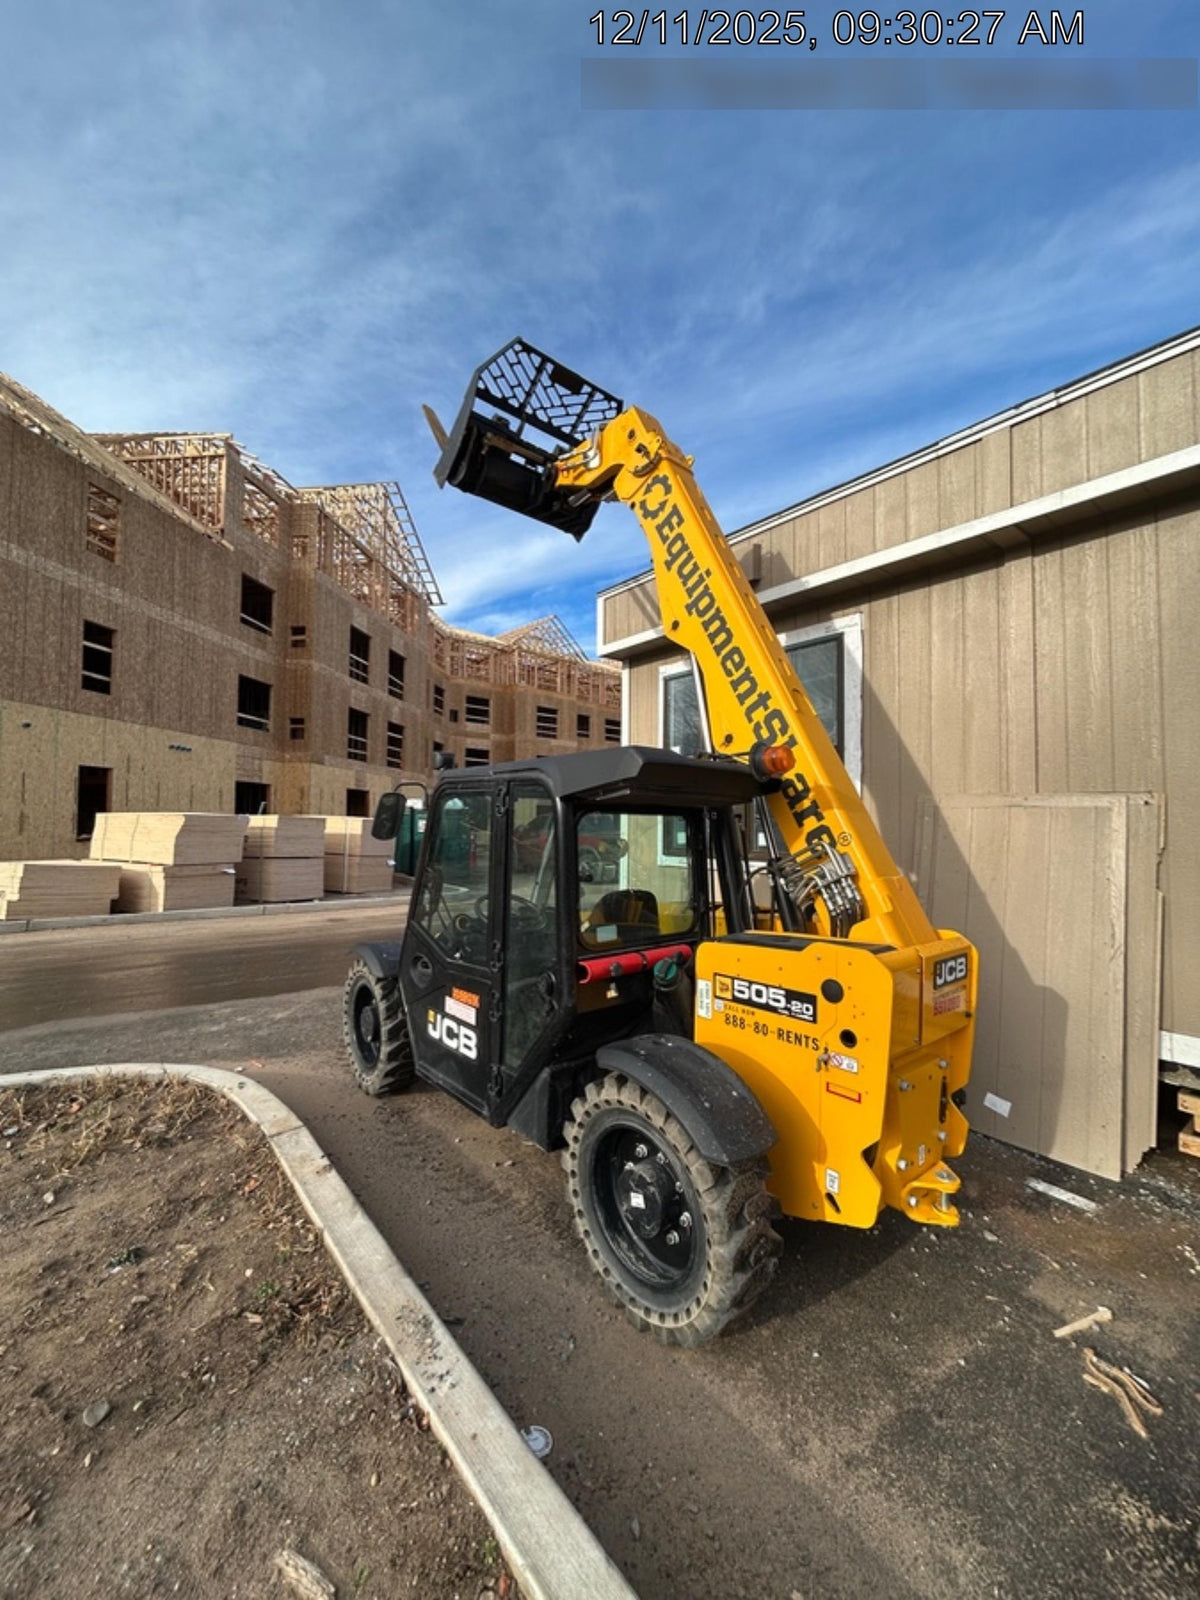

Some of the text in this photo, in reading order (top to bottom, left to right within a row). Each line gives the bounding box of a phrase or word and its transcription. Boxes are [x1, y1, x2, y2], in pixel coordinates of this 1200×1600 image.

[655, 503, 838, 858] EquipmentSare
[936, 957, 966, 985] JCB
[427, 1010, 478, 1060] JCB
[724, 1013, 819, 1051] 888-80-RENTS
